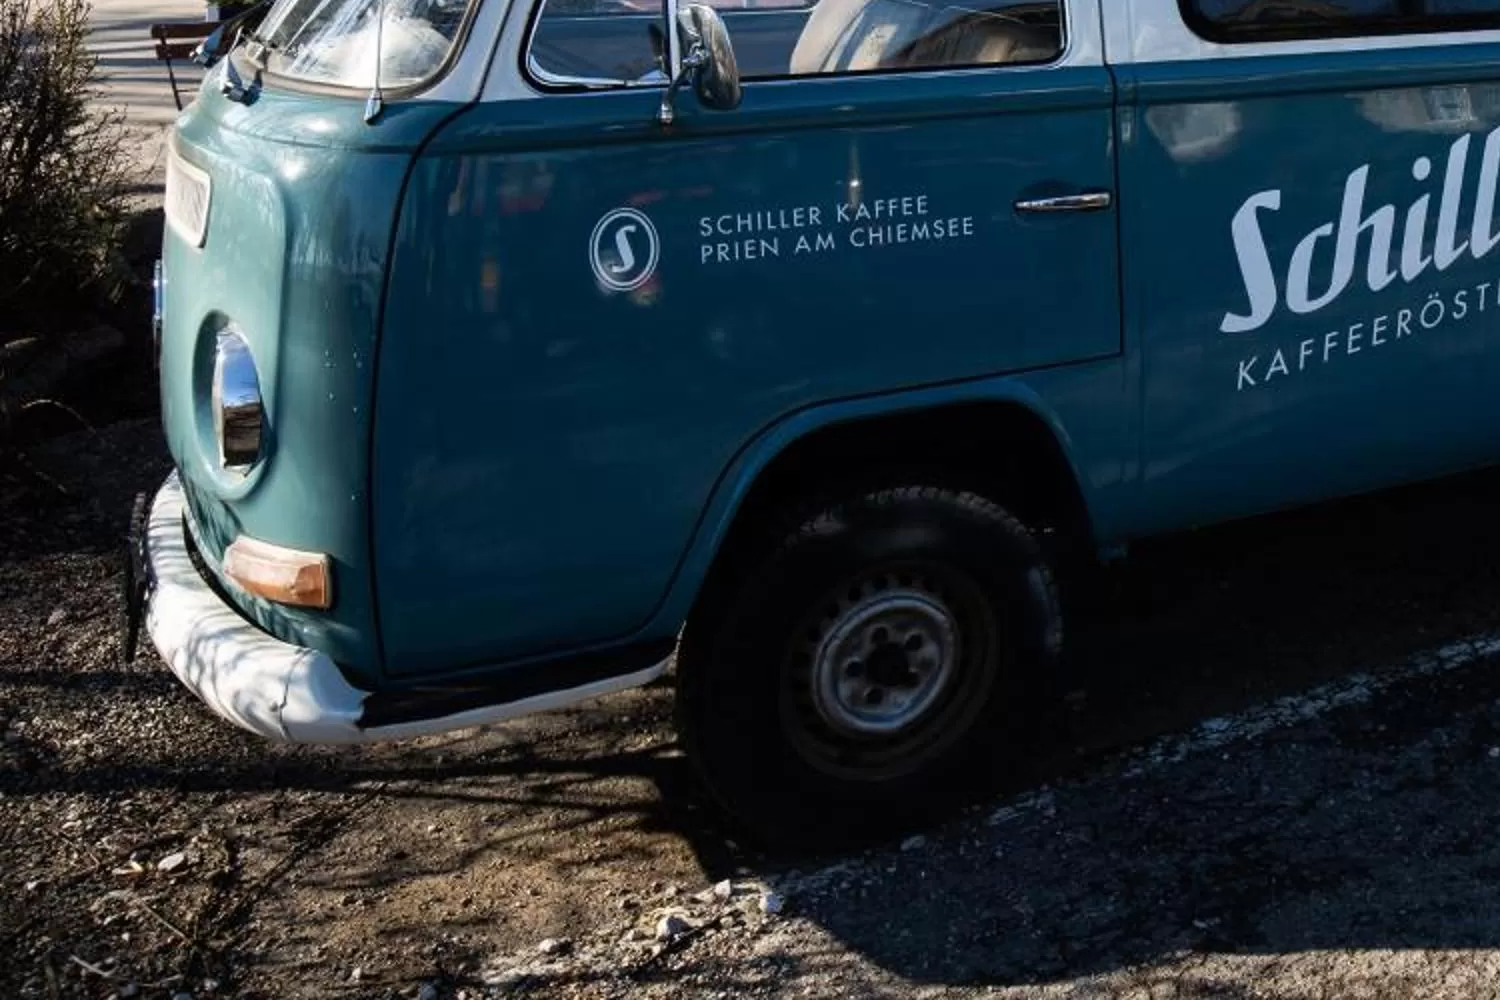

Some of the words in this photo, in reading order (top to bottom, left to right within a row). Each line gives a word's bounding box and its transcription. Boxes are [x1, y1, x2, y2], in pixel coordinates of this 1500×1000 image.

[699, 206, 822, 237] SCHILLER
[836, 195, 929, 223] KAFFEE
[700, 236, 779, 264] PRIEN
[794, 232, 836, 254] AM
[849, 216, 974, 247] CHIEMSEE
